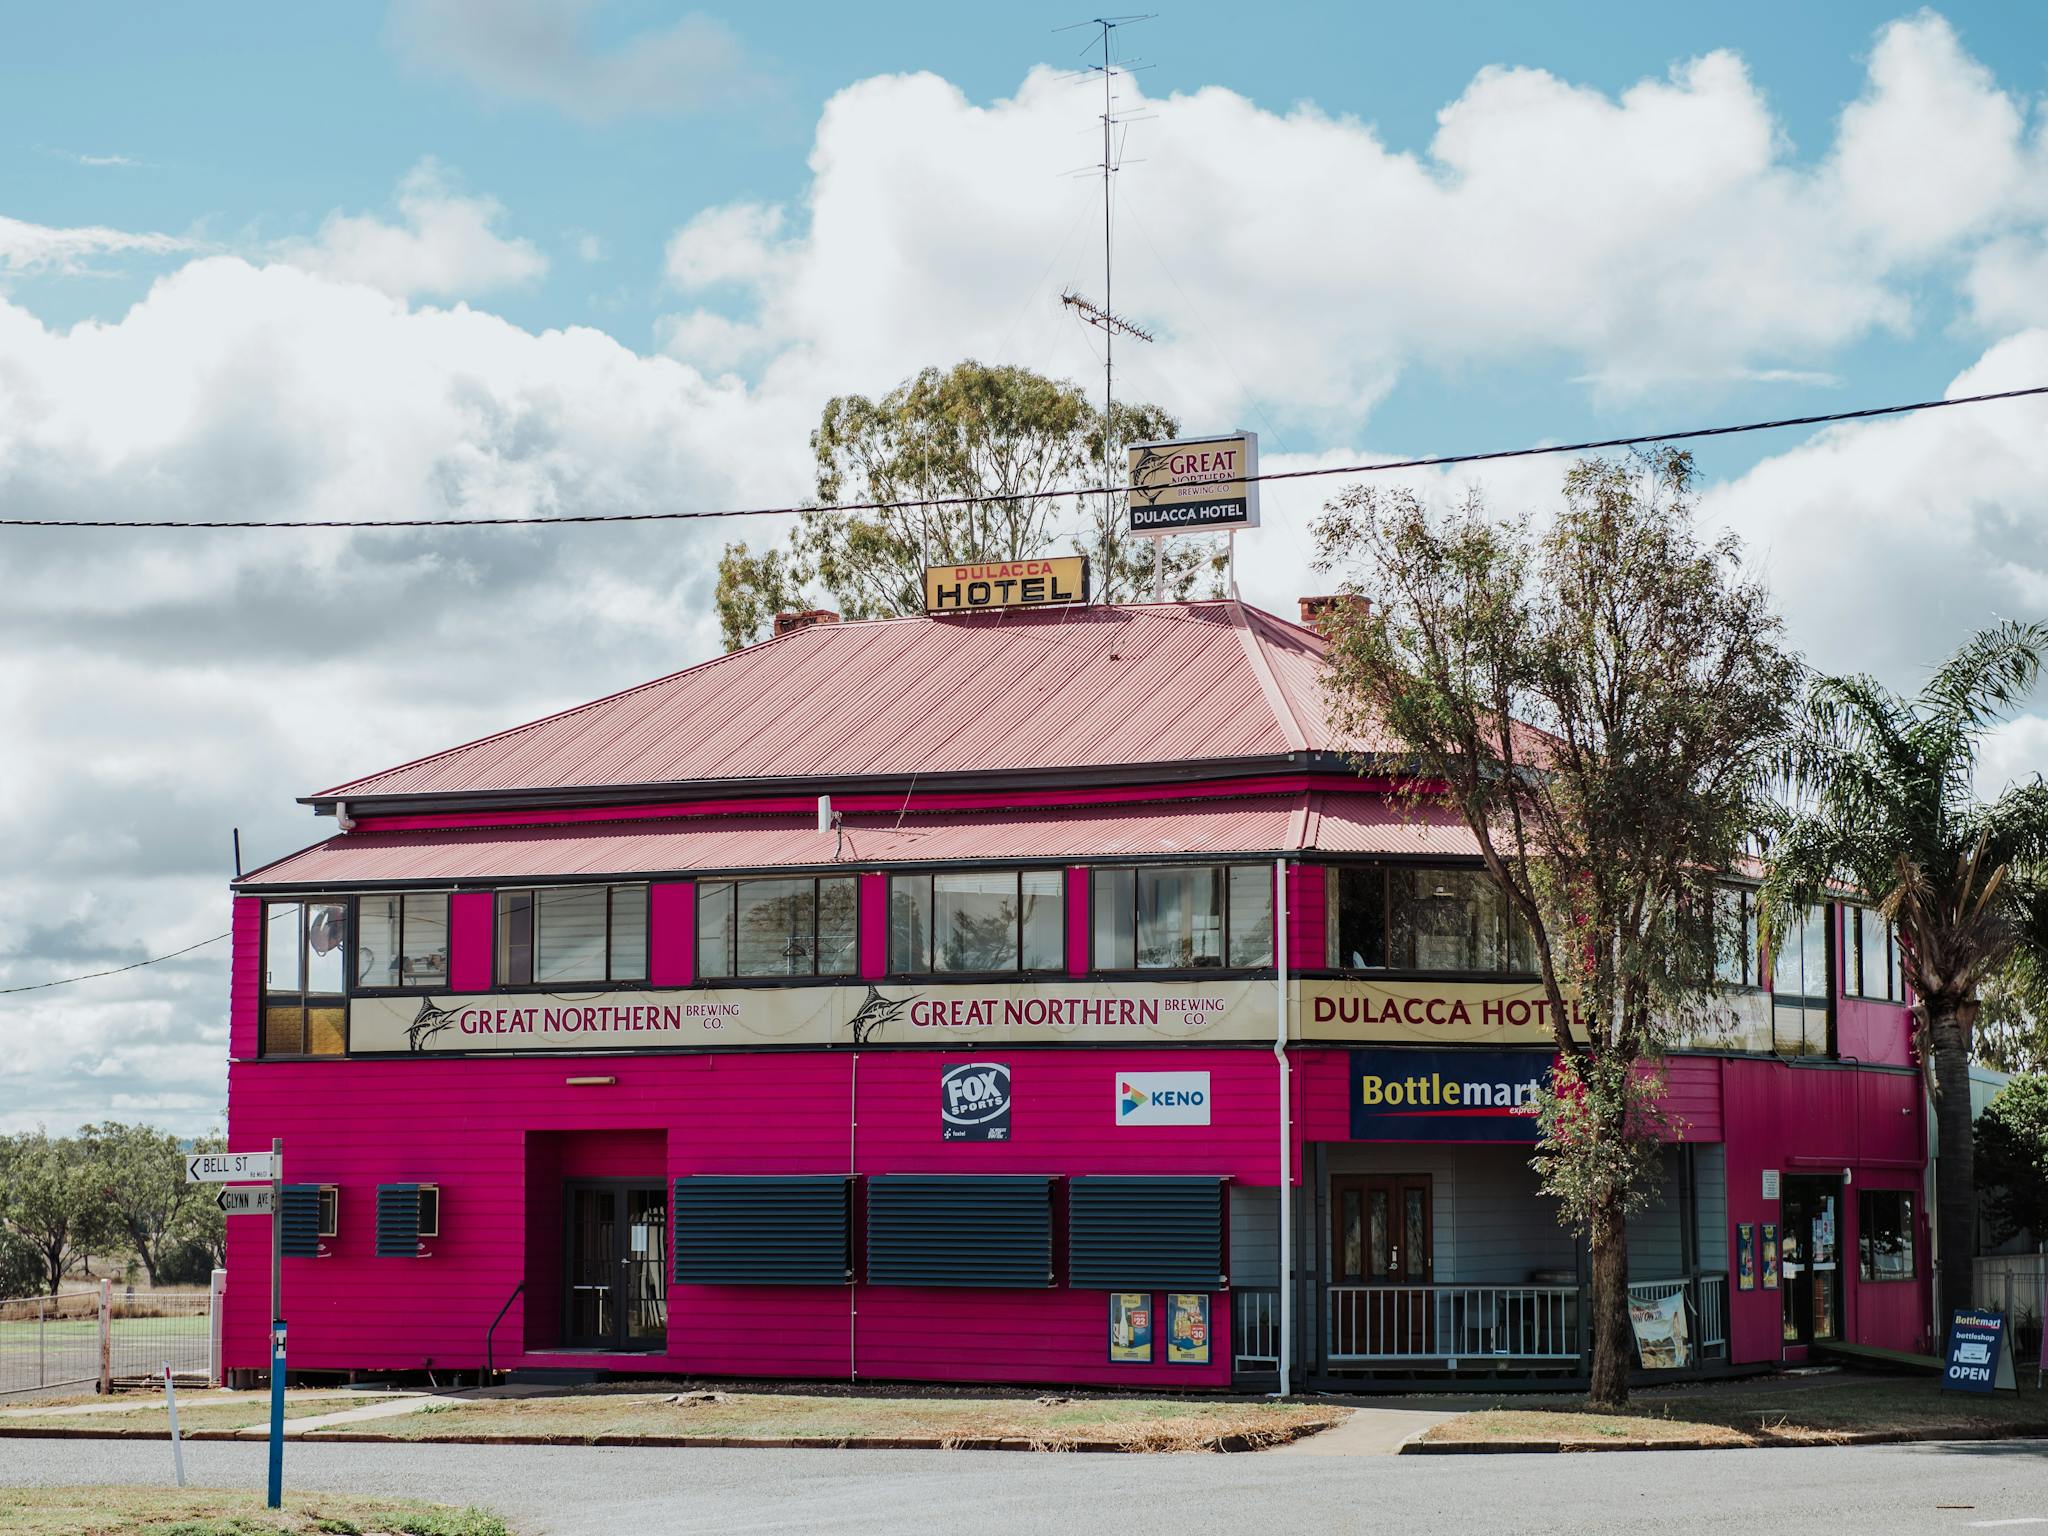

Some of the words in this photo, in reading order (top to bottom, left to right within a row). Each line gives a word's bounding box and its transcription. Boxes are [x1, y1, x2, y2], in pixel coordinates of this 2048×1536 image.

[1169, 450, 1237, 475] GREAT
[1178, 486, 1214, 497] BREWING
[1134, 508, 1197, 525] DULACCA
[1199, 503, 1243, 519] HOTEL
[955, 562, 1054, 581] DULACCA
[936, 576, 1073, 608] HOTEL
[685, 1004, 740, 1017] BREWING
[910, 1000, 1000, 1027] GREAT
[1003, 999, 1160, 1026] NORTHERN
[1164, 998, 1225, 1012] BREWING
[1314, 997, 1471, 1025] DULACCA
[460, 1009, 541, 1034] GREAT
[543, 1005, 682, 1033] NORTHERN
[703, 1018, 724, 1030] CO.
[1183, 1012, 1208, 1026] CO.
[946, 1070, 1002, 1107] FOX
[1362, 1073, 1541, 1106] Bottlemart
[950, 1095, 1004, 1116] SPORTS
[1151, 1091, 1204, 1107] KENO
[204, 1158, 229, 1172] BELL
[235, 1157, 248, 1171] ST
[226, 1193, 249, 1208] GLYNN
[257, 1192, 269, 1208] AVE
[1955, 1315, 2001, 1327] Bottlemart
[276, 1337, 286, 1352] H
[1956, 1331, 1995, 1342] bottleshop
[1949, 1365, 1990, 1381] OPEN
